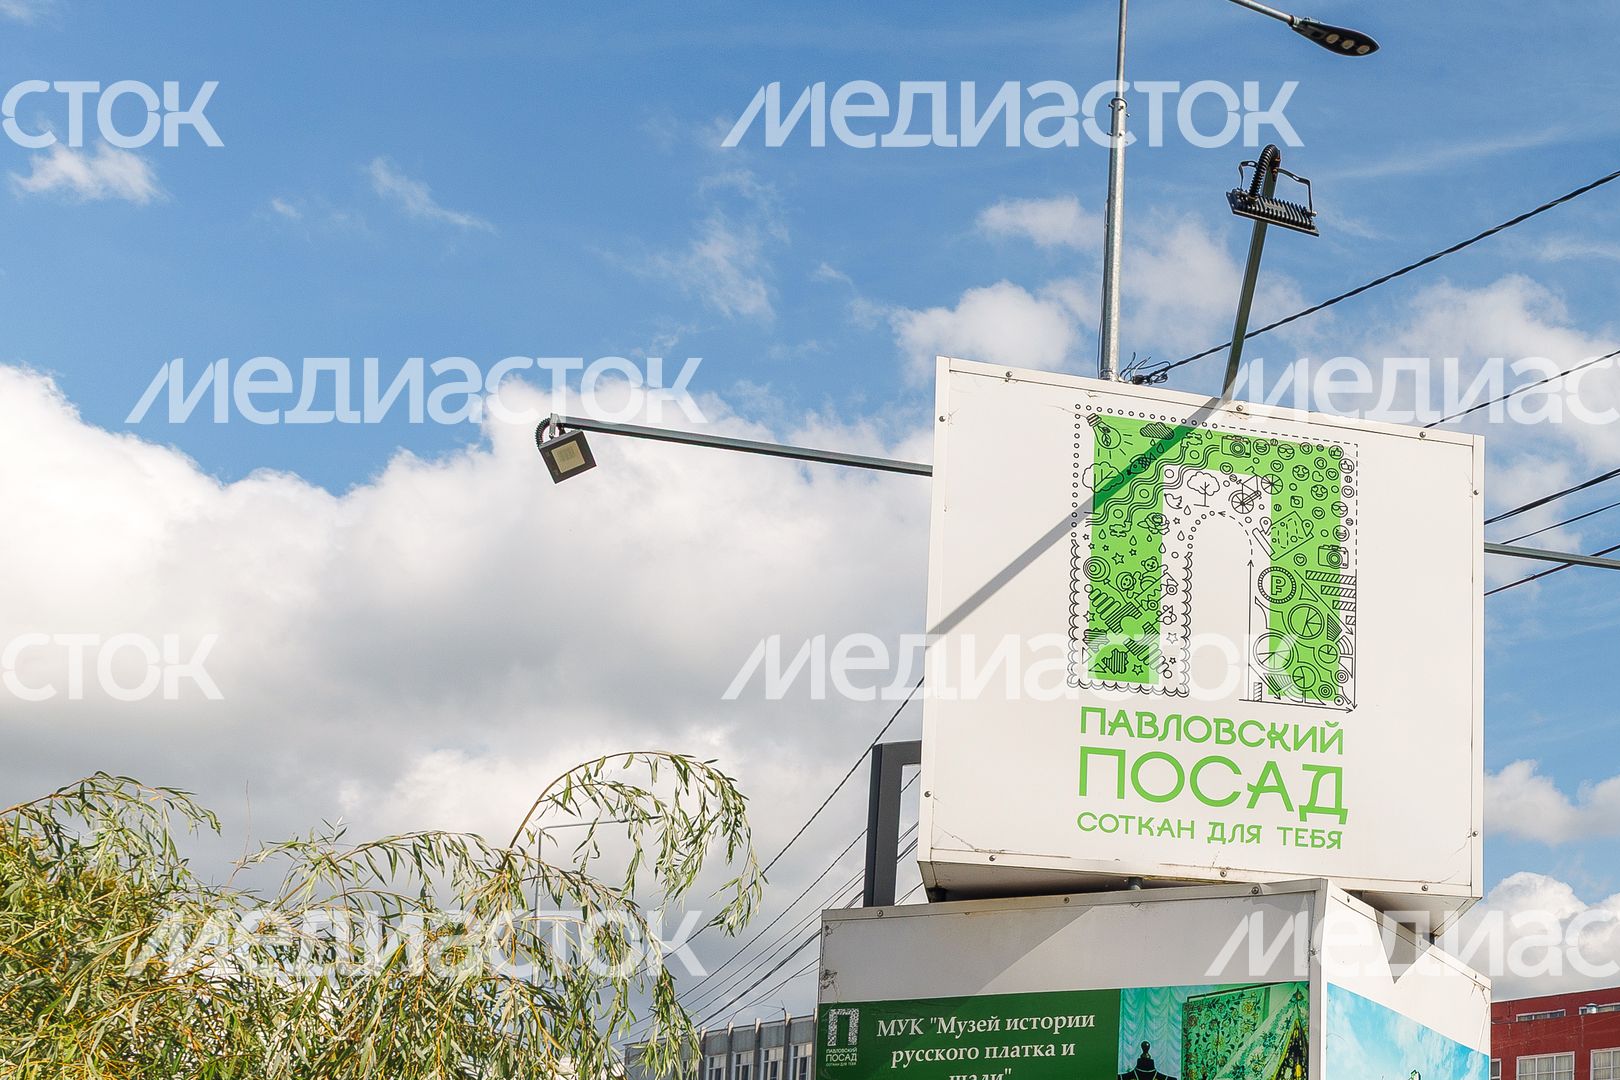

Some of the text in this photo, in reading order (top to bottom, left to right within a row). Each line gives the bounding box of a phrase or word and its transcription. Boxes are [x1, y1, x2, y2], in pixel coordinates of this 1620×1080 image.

[1080, 706, 1344, 756] ПАВЛОВСКИЙ
[1078, 745, 1348, 825] ПОСАД
[1077, 812, 1342, 850] СОТКАН ДЛЯ ТЕБЯ
[876, 1012, 1096, 1039] МУК "Музей истории
[826, 1053, 857, 1062] ПОСАД
[891, 1041, 1075, 1068] русского платка и
